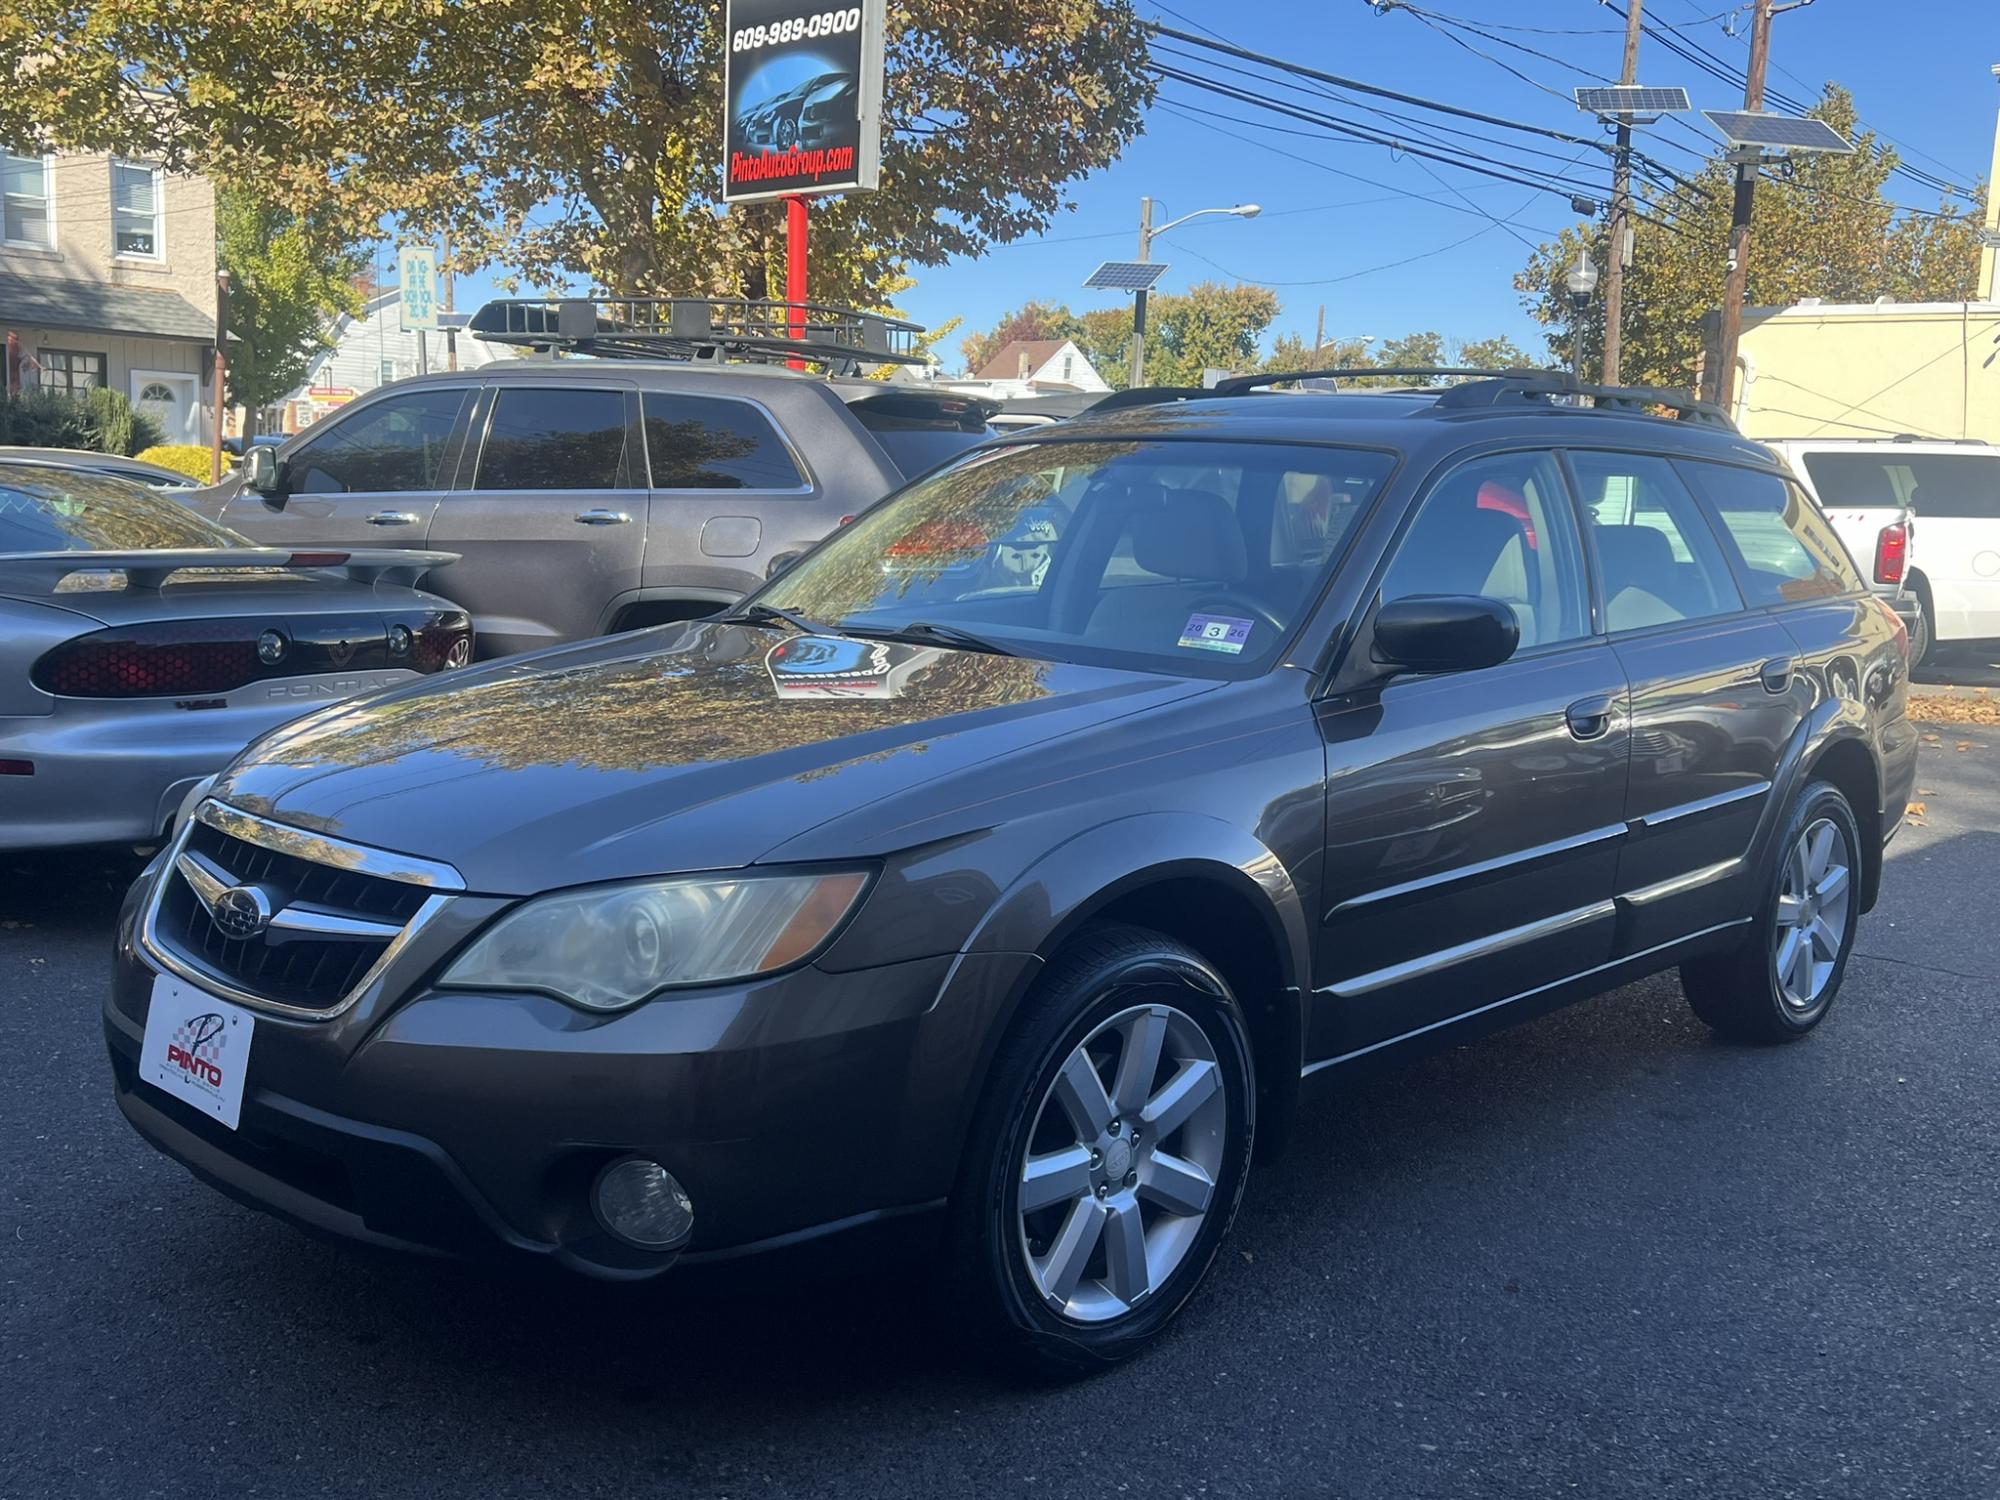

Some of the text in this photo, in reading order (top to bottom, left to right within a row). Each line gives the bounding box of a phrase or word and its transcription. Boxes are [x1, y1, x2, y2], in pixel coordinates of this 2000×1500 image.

[732, 7, 861, 52] 609-989-0900
[730, 144, 853, 183] PintoAutoGroup.com
[299, 415, 311, 425] 25
[1187, 623, 1203, 632] 20
[1209, 627, 1221, 637] 3
[167, 1043, 222, 1087] PINTO
